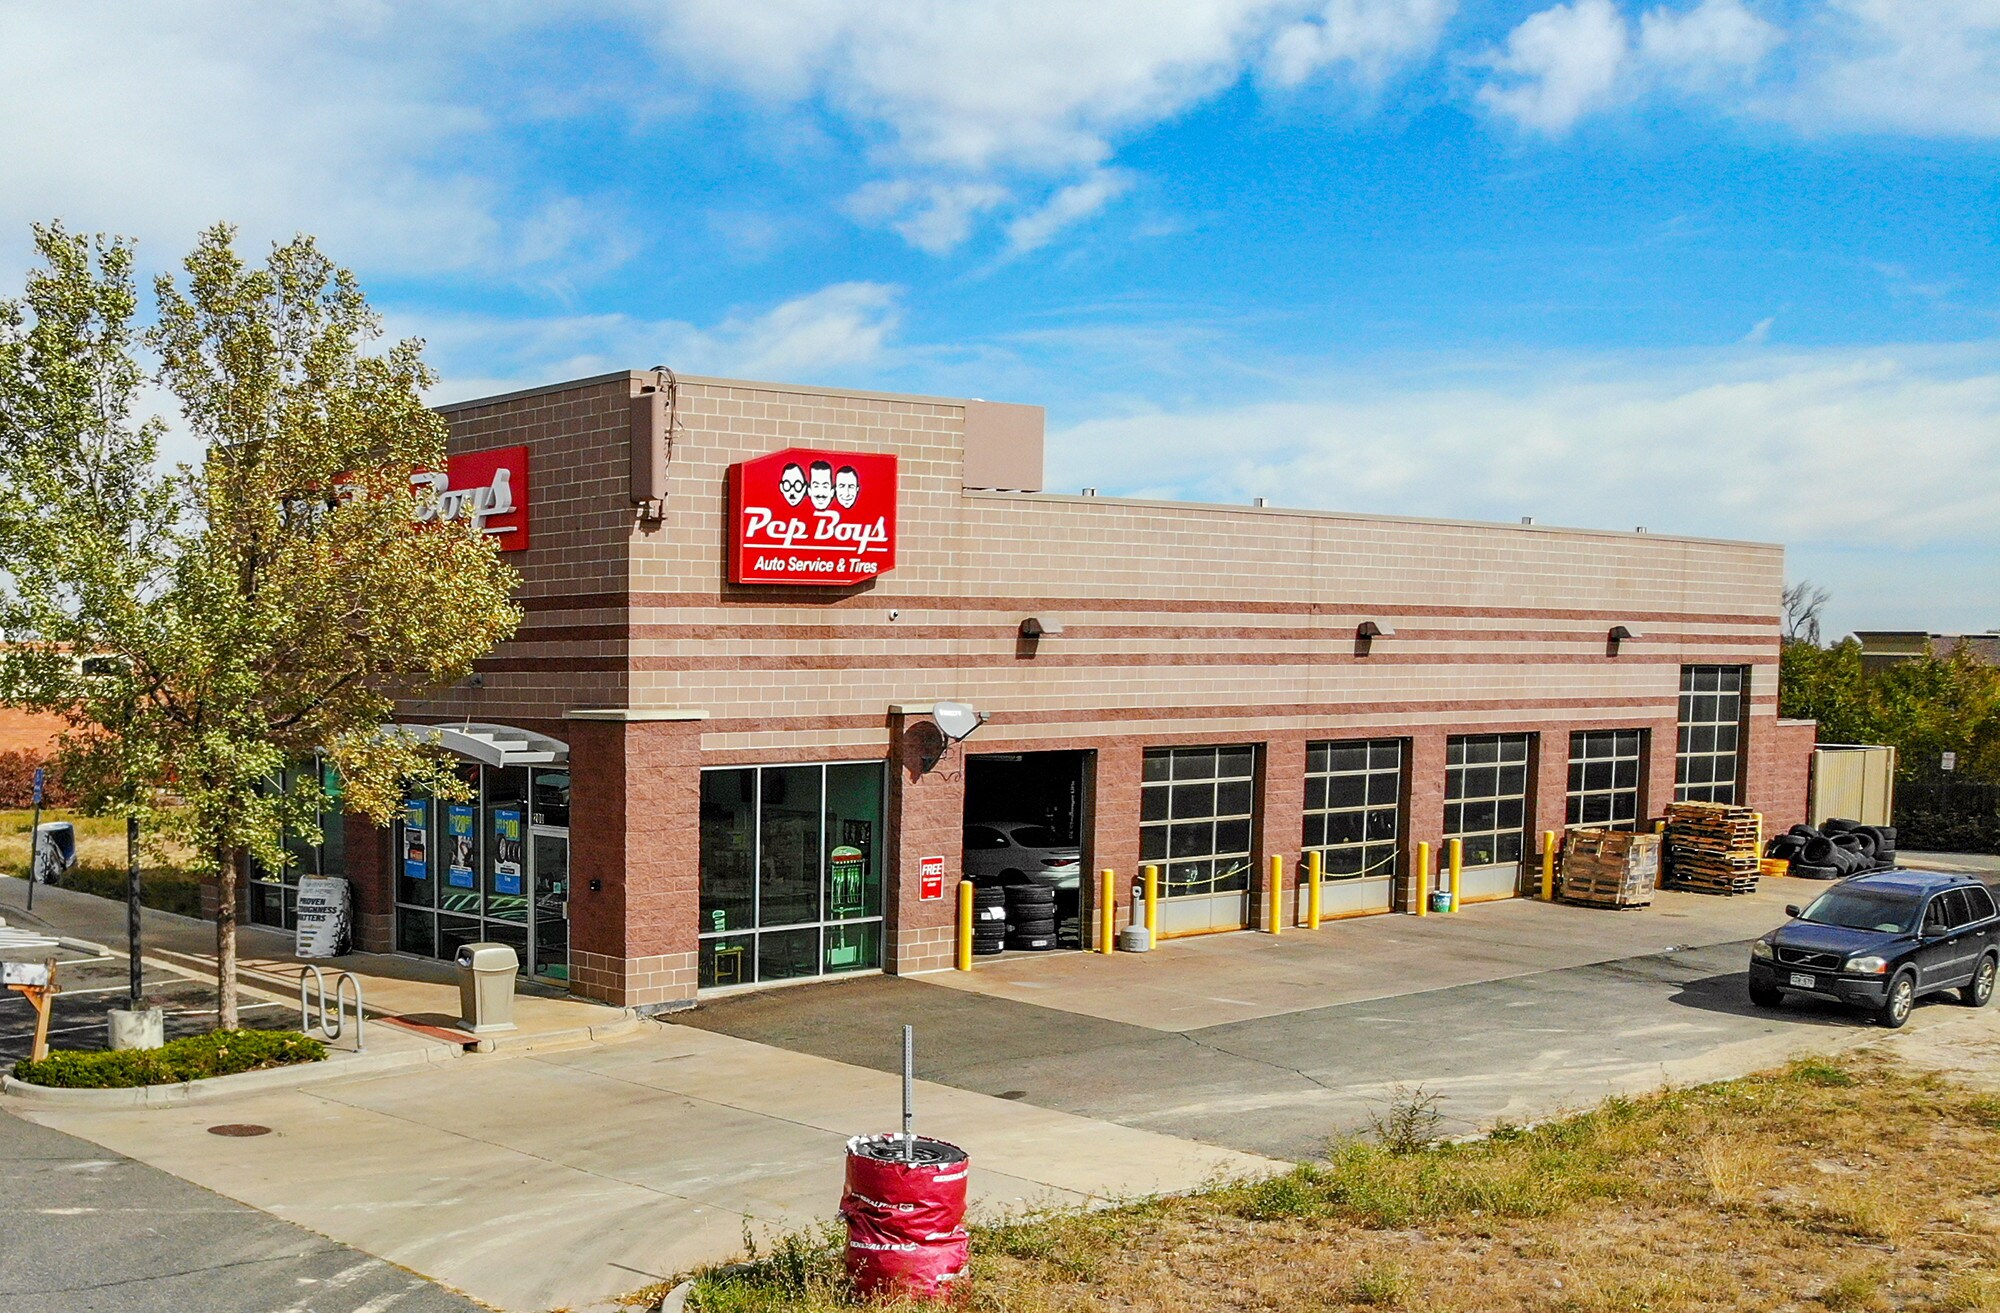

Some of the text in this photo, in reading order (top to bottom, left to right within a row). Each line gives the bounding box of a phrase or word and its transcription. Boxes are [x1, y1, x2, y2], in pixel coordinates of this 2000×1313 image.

[409, 468, 517, 533] Boys
[744, 507, 888, 555] Pep Boys
[754, 555, 878, 573] Auto Service & Tires
[922, 863, 942, 876] FREE
[299, 897, 326, 906] PROVEN
